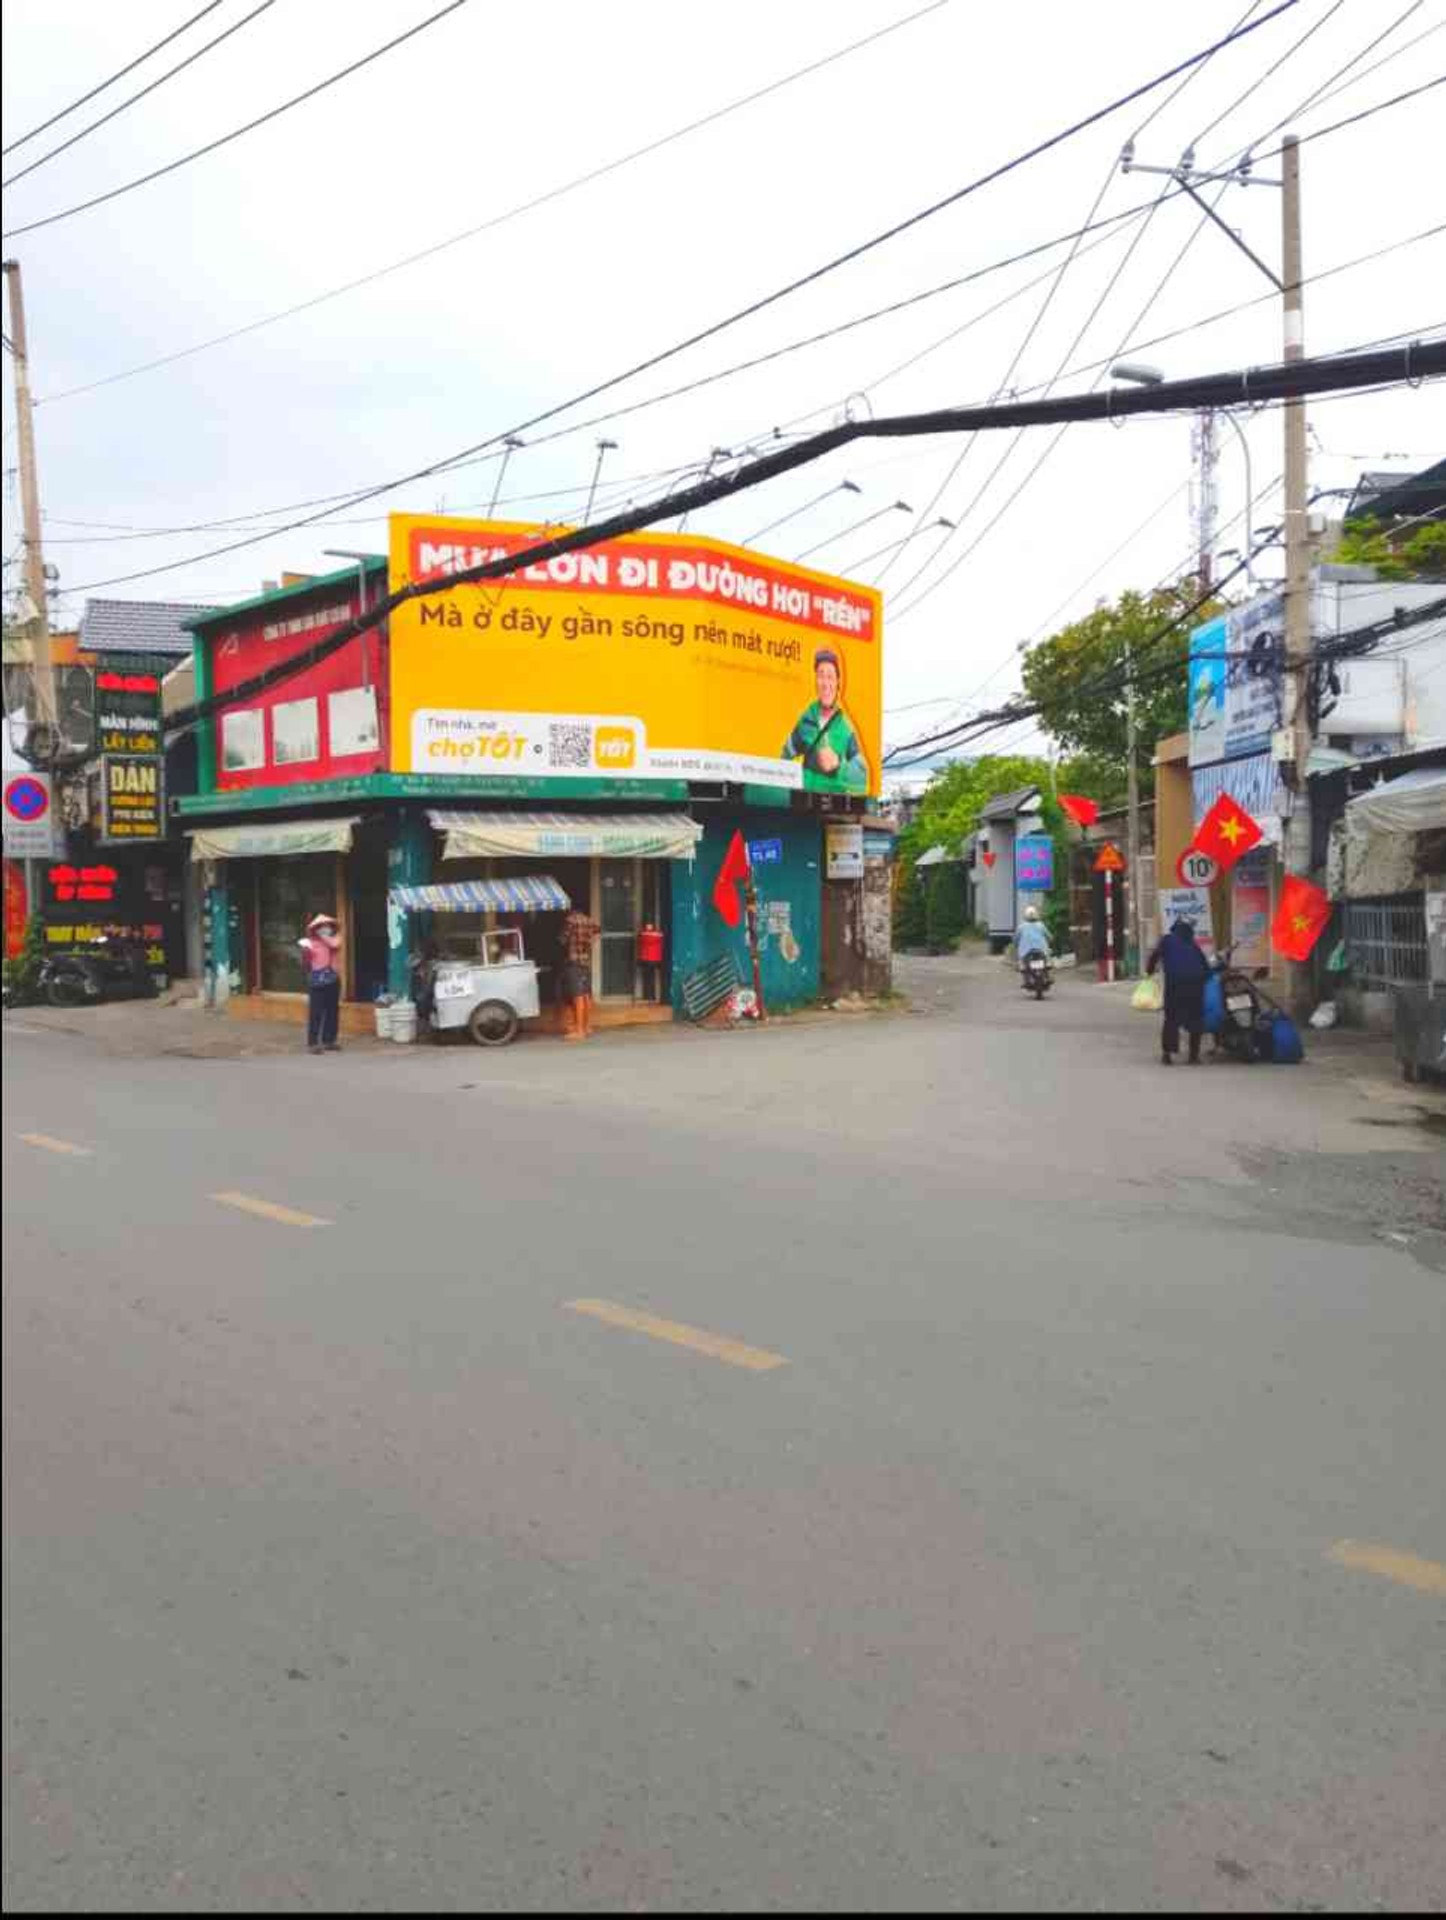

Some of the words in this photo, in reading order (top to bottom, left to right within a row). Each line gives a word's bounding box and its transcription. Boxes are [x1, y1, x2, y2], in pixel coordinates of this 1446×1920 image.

[618, 557, 659, 588] ĐI
[667, 559, 769, 606] ĐƯỜNG
[419, 603, 463, 628] Mà
[473, 604, 493, 629] ở
[500, 607, 552, 638] đây
[562, 606, 613, 640] gần
[622, 615, 685, 646] sông
[693, 619, 727, 647] nên
[731, 627, 763, 655] mát
